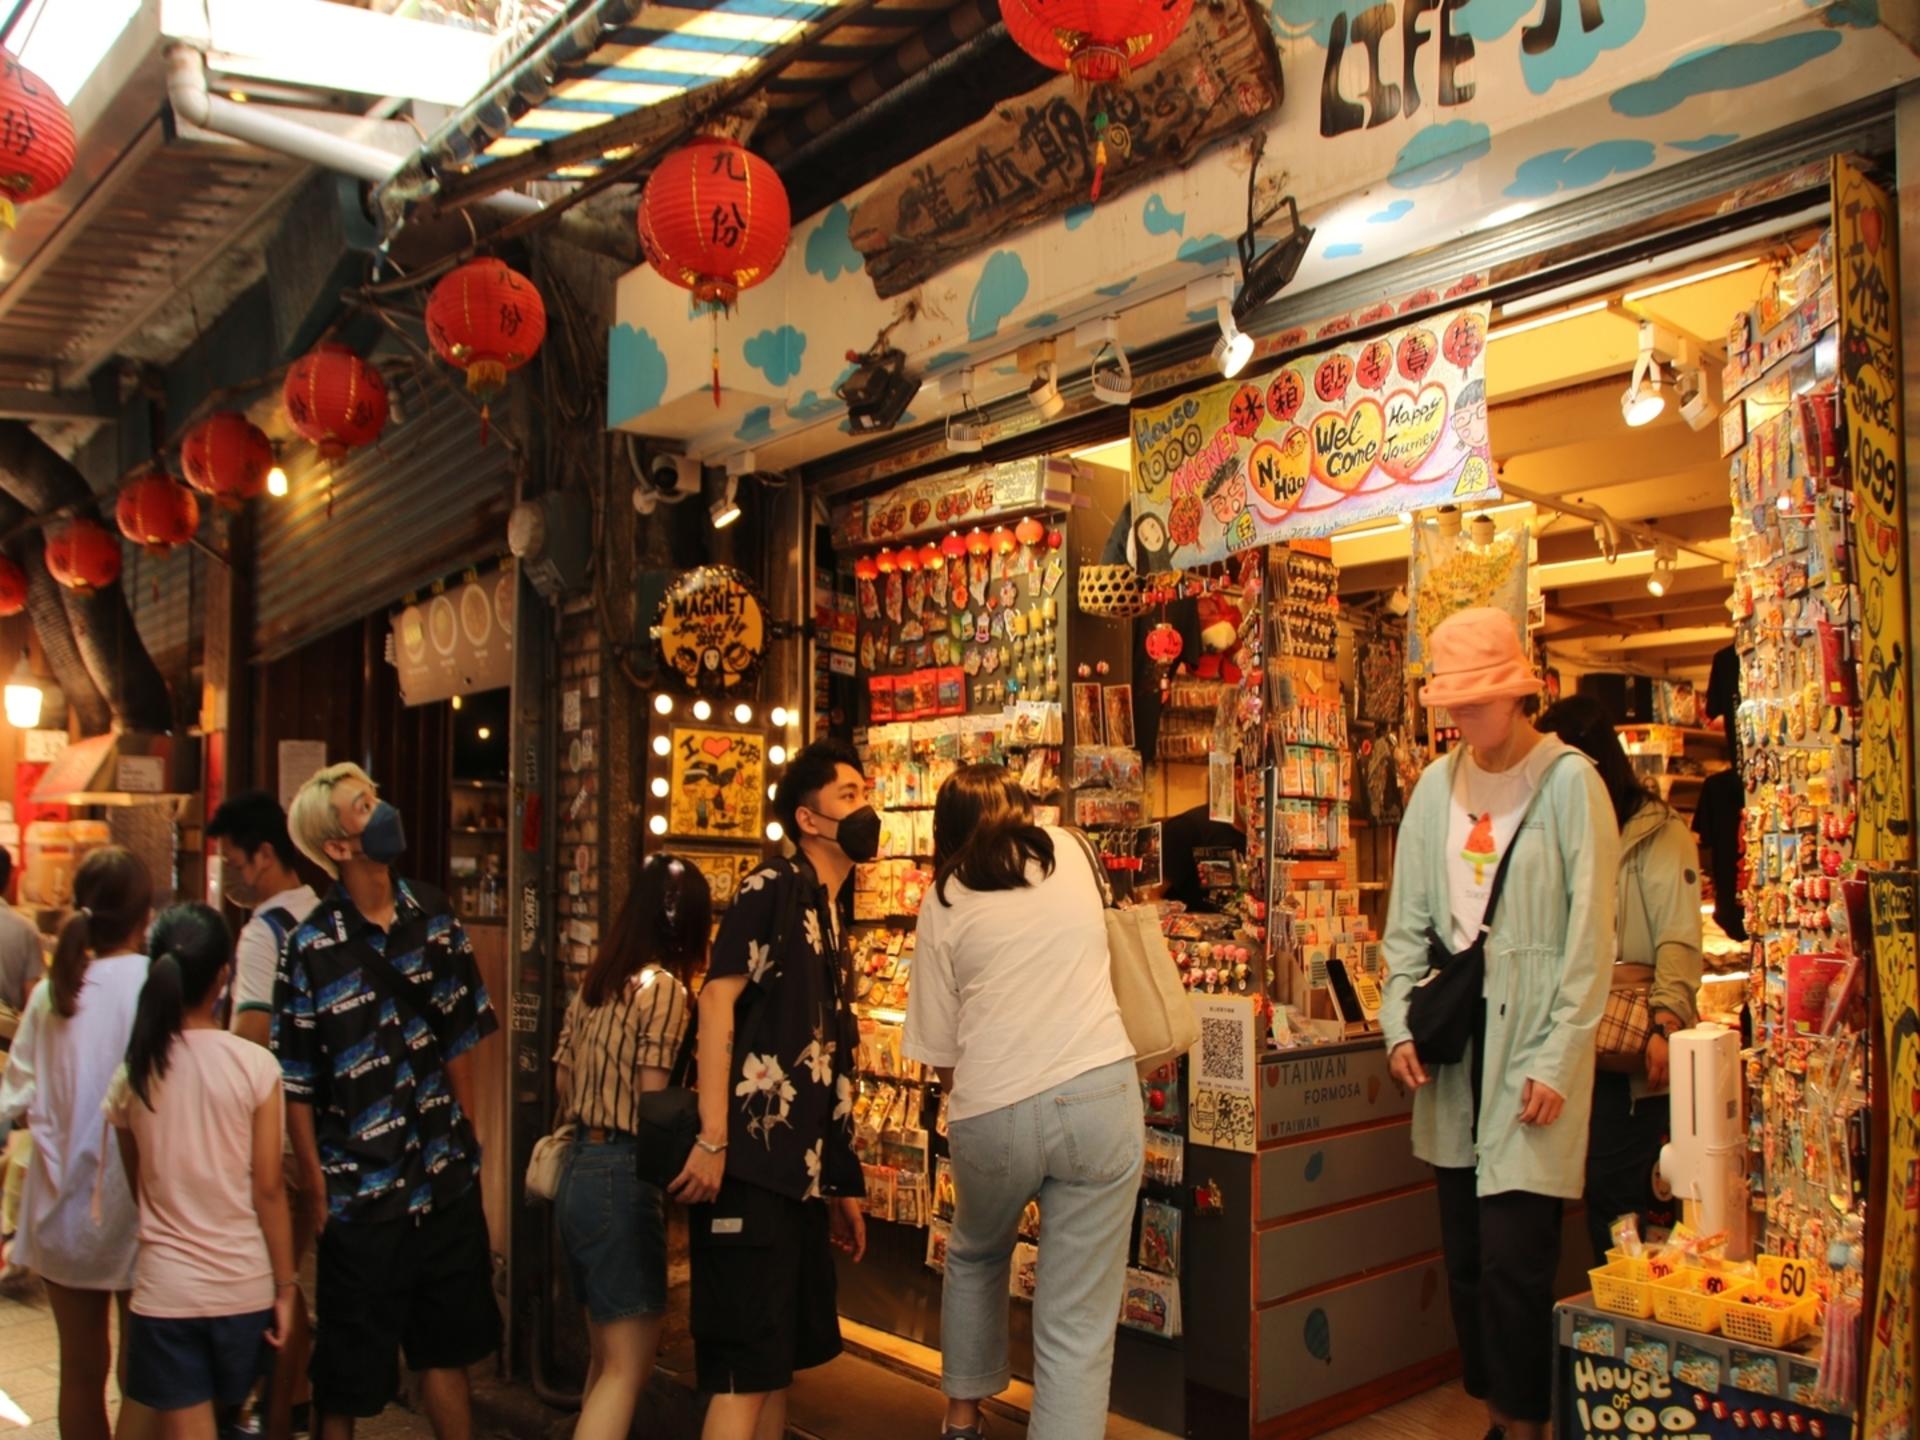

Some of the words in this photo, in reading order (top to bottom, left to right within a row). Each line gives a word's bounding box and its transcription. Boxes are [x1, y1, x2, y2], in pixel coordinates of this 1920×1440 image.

[1320, 0, 1476, 138] LIFE
[710, 150, 747, 248] 九份
[1387, 397, 1443, 429] Happy
[1137, 424, 1203, 494] 1000
[1256, 453, 1281, 489] Ni
[1855, 426, 1896, 517] 1999
[673, 591, 748, 618] MAGNET
[680, 735, 700, 761] I
[1281, 1056, 1347, 1086] TAIWAN
[1304, 1082, 1361, 1105] FORMOSA
[1279, 1116, 1321, 1135] TAIWAN
[1779, 1263, 1806, 1298] 60
[1576, 1397, 1697, 1434] 1000
